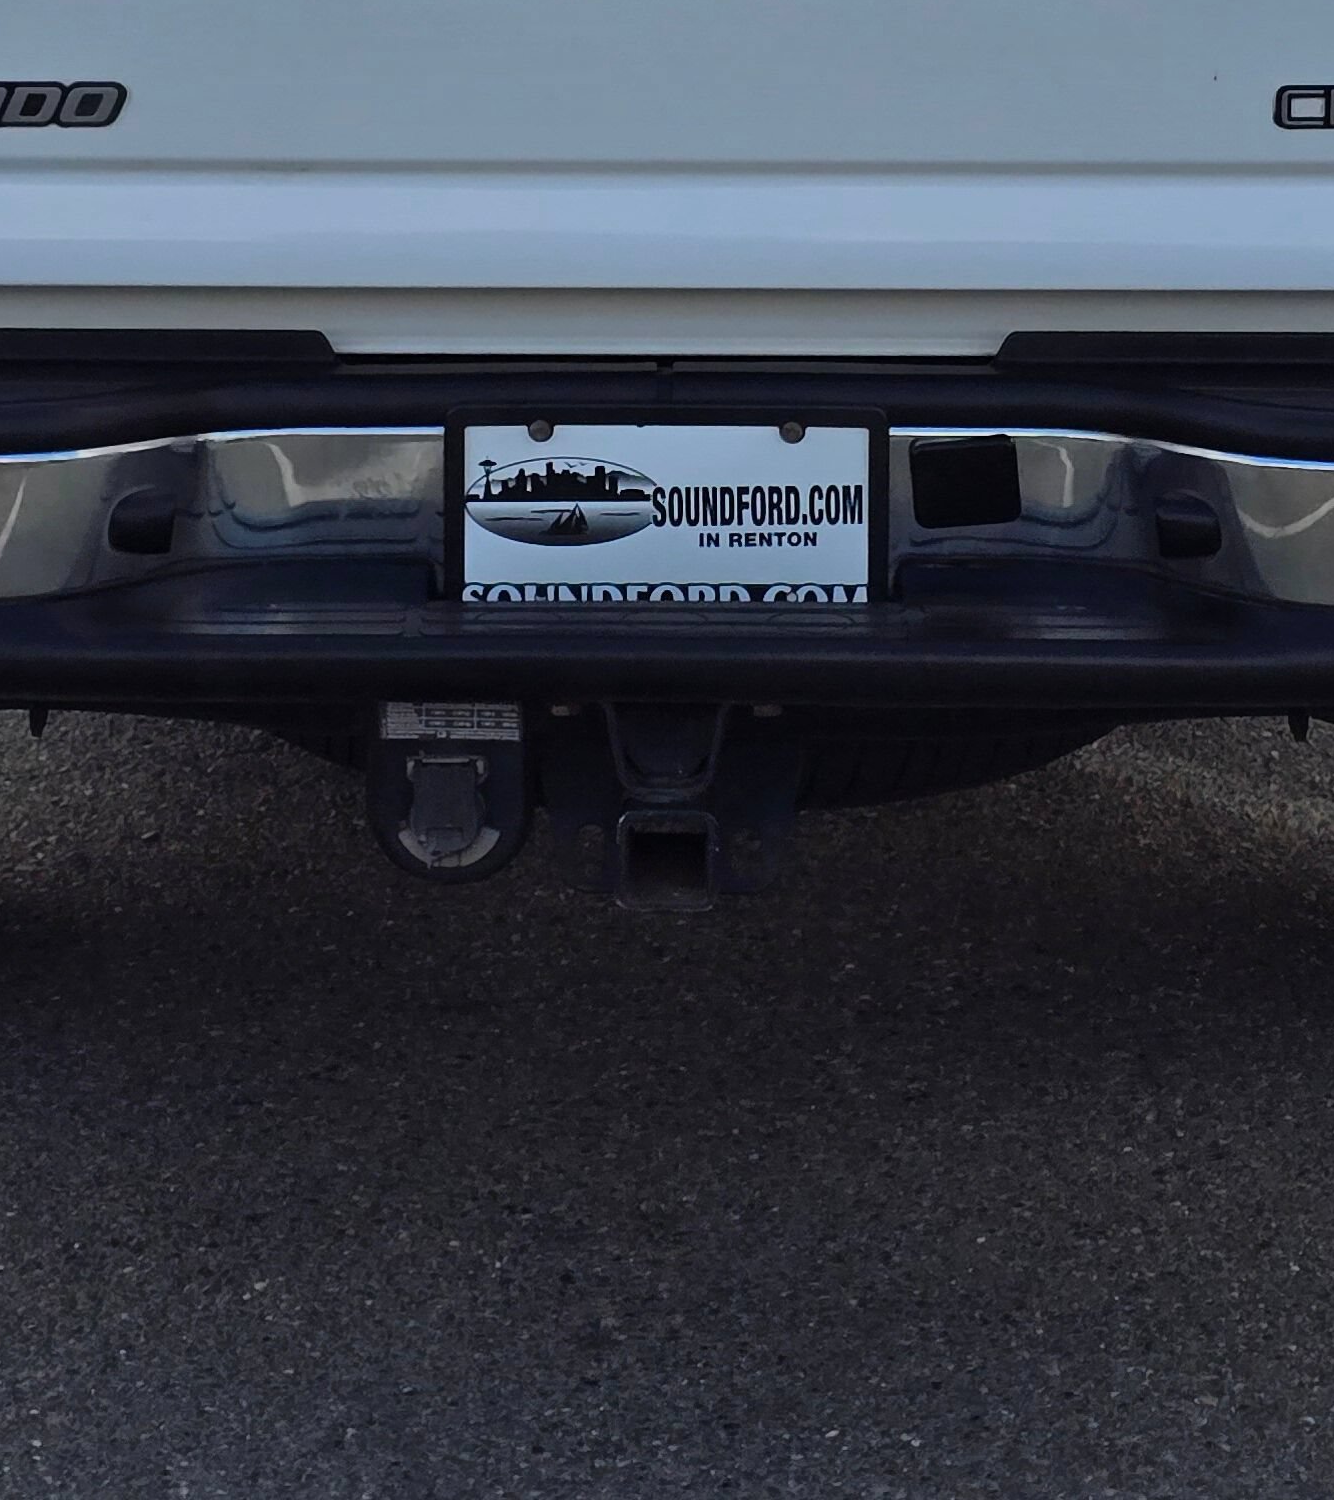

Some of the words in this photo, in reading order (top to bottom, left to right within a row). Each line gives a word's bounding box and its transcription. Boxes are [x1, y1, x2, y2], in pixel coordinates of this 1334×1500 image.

[651, 485, 864, 527] SOUNDFORD.COM
[698, 532, 720, 547] IN
[729, 531, 818, 547] RENTON
